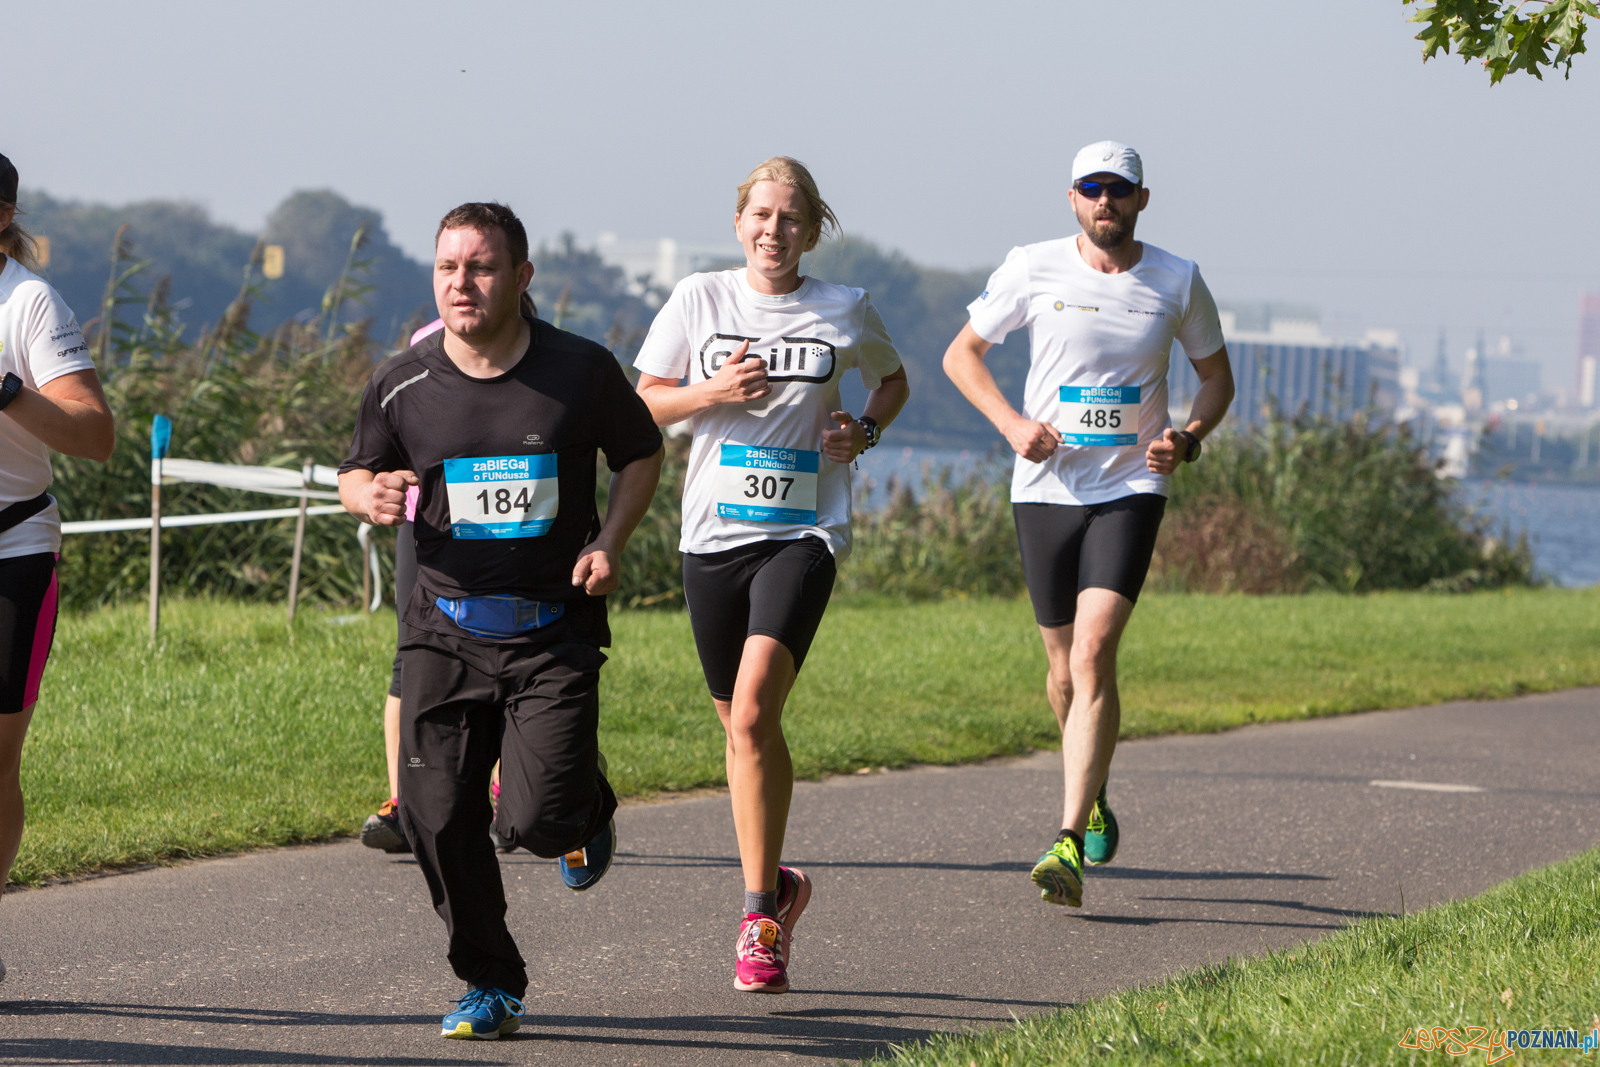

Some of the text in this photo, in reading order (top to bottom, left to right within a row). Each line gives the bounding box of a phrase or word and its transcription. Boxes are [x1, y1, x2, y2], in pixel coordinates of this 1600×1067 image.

[711, 347, 807, 371] cill
[1080, 387, 1122, 397] zaBIEGaj
[1087, 396, 1121, 404] FUNdusze
[1080, 409, 1122, 428] 485
[745, 448, 797, 464] zaBIEGaj
[472, 458, 529, 472] zaBIEGaj
[753, 459, 796, 470] FUNdusze
[482, 471, 530, 481] FUNdusze
[744, 474, 795, 501] 307
[476, 487, 532, 515] 184
